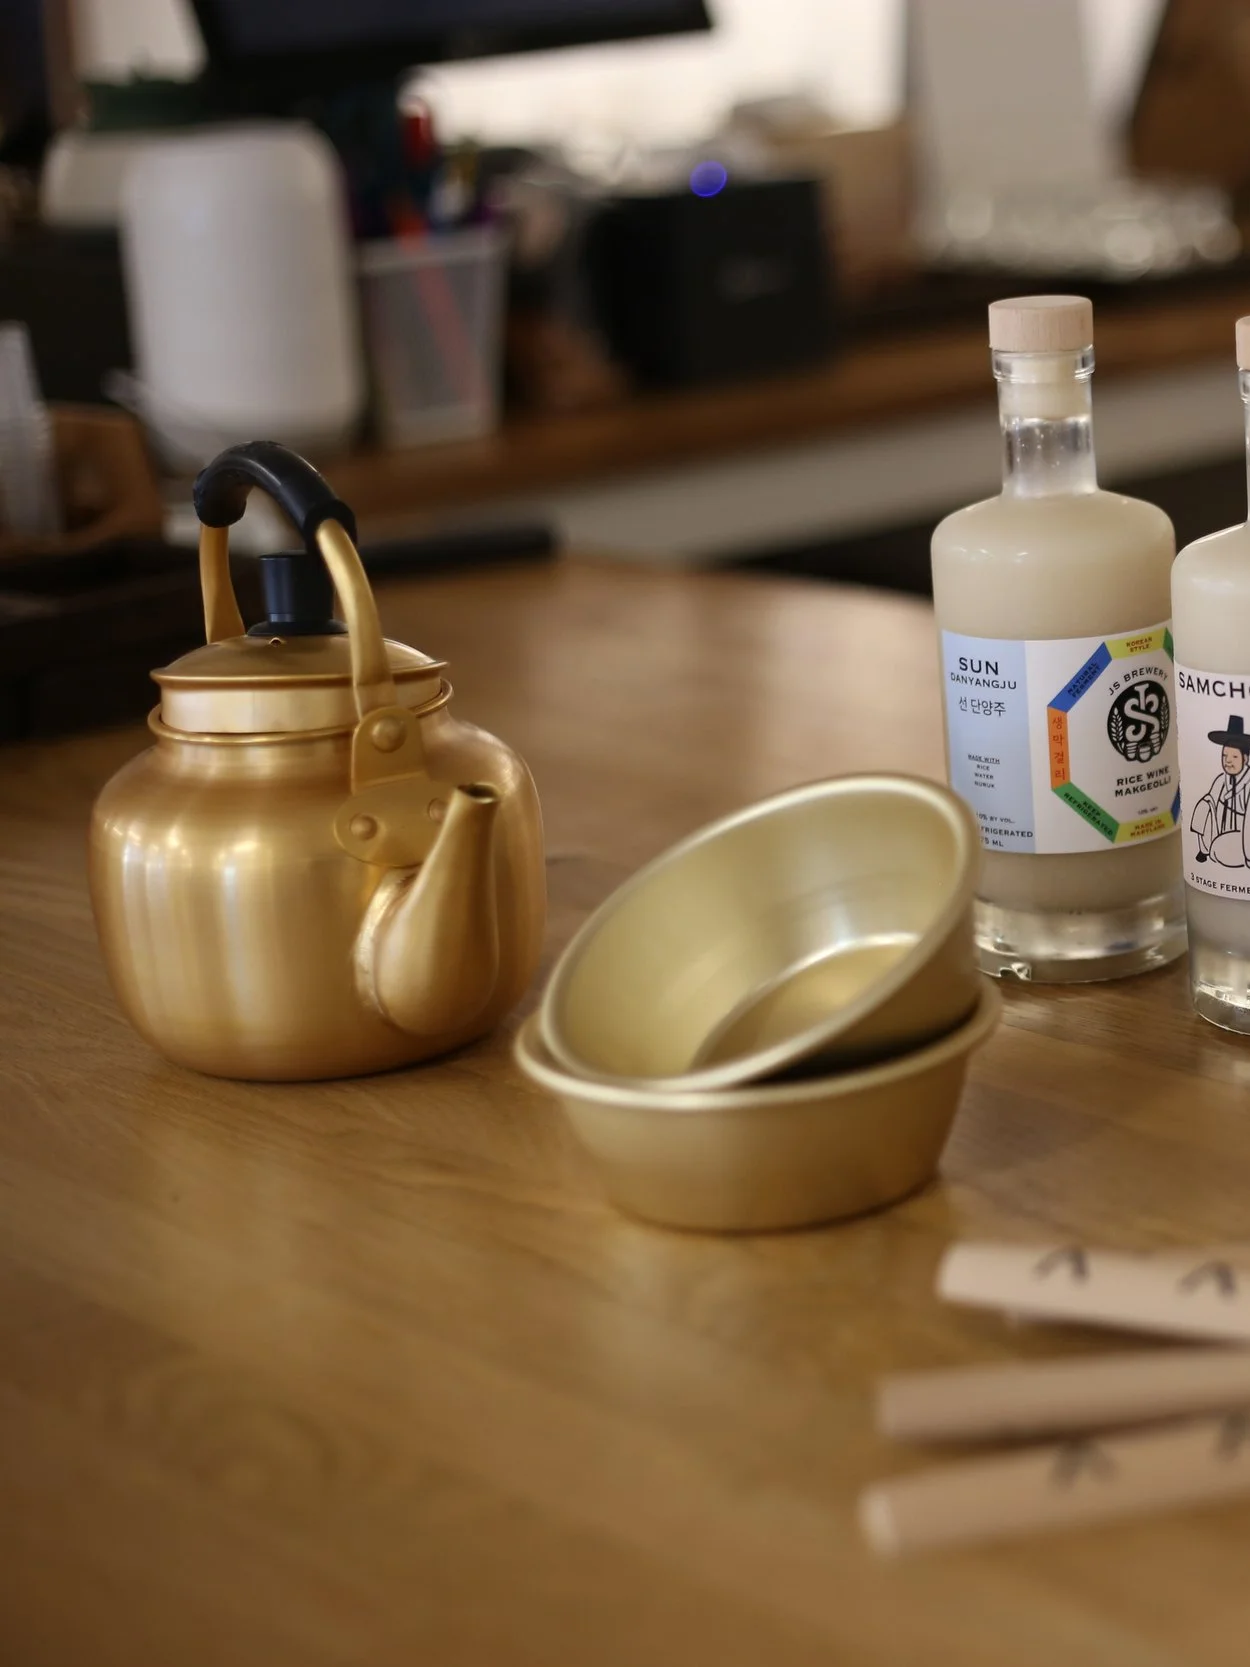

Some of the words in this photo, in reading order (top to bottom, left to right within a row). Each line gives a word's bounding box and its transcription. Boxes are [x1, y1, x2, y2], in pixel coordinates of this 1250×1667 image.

[1126, 637, 1153, 648] KOREAN
[959, 657, 999, 676] SUN
[950, 672, 1017, 690] DANYANGJU
[1108, 681, 1121, 696] JS
[1123, 666, 1168, 682] BREWERY
[959, 697, 968, 712] 선
[970, 699, 1007, 717] 단양주
[1052, 717, 1066, 780] 생막걸리
[974, 772, 994, 780] WATER
[1116, 774, 1143, 787] RICE
[1146, 766, 1169, 780] WINE
[1115, 776, 1171, 798] MAKGEOLLI
[1063, 792, 1113, 836] REFRIGERATED
[1196, 876, 1217, 889] STAGE
